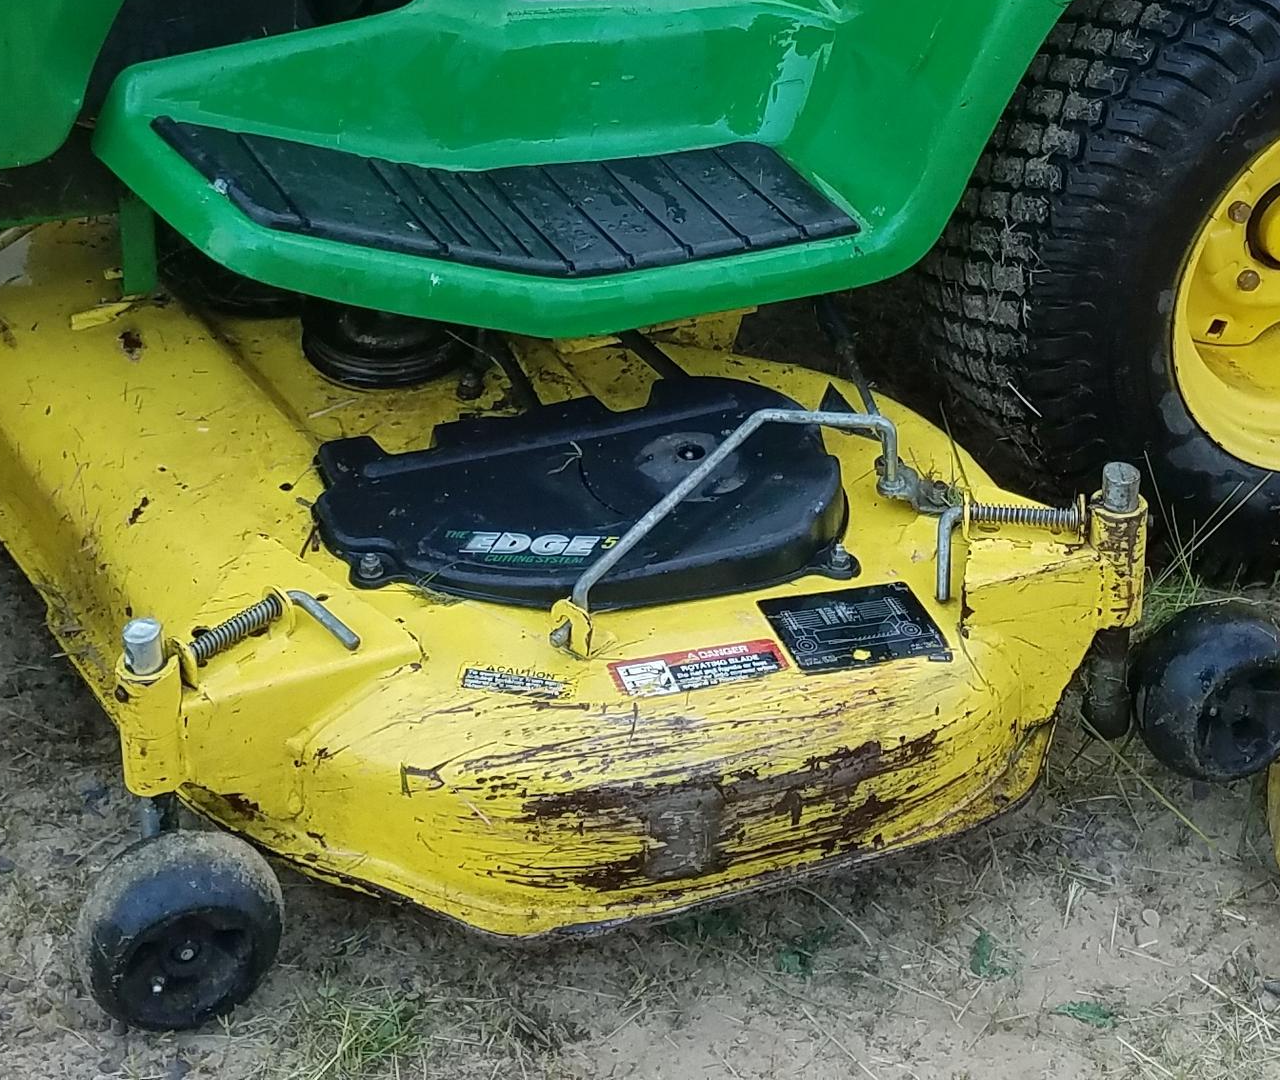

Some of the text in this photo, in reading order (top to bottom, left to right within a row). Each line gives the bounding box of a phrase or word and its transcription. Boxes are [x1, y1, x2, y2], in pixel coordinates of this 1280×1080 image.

[445, 530, 470, 539] THE
[459, 531, 601, 557] EDGE
[484, 554, 585, 565] CUTTING SYSTEM
[699, 645, 749, 660] DANGER
[680, 654, 760, 672] ROTATING BLADE
[496, 665, 556, 681] CAUTION
